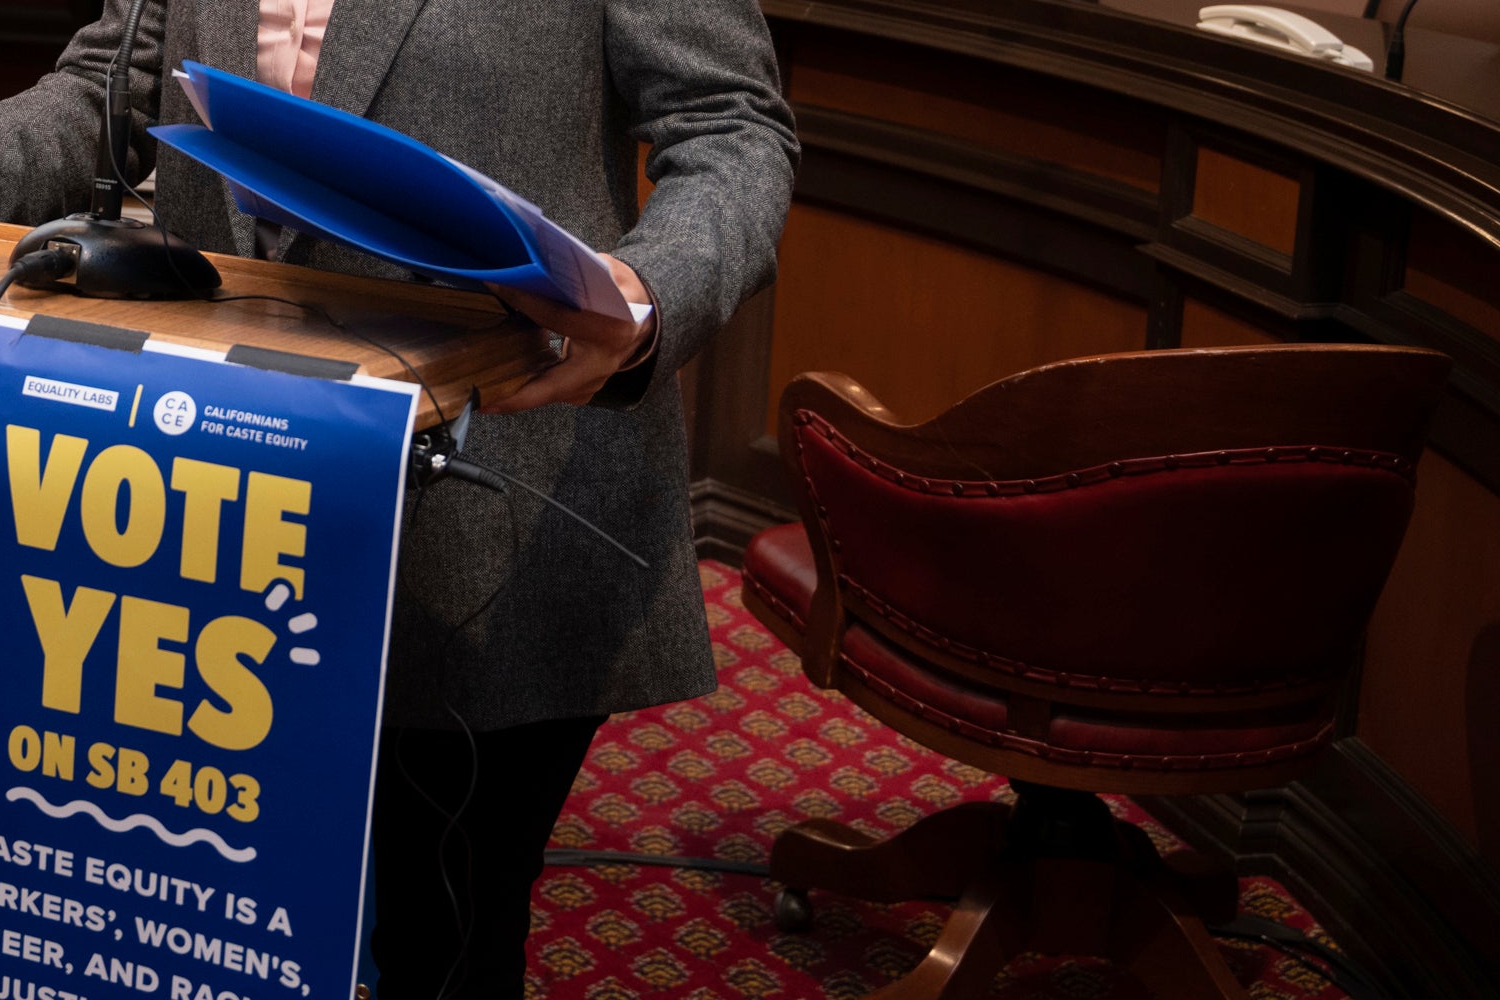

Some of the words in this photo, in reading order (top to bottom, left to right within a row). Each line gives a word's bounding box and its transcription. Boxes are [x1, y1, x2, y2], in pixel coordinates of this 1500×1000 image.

[27, 381, 81, 399] EQUALITY
[83, 391, 113, 405] LABS
[204, 405, 289, 431] CALIFORNIANS
[201, 421, 223, 435] FOR
[225, 426, 263, 443] CASTE
[265, 433, 308, 451] EQUITY
[6, 424, 312, 601] VOTE
[20, 574, 278, 751] YES
[8, 725, 76, 781] ON
[85, 742, 150, 796] SB
[159, 759, 261, 823] 403
[85, 856, 216, 912] EQUITY
[224, 893, 258, 925] IS
[267, 907, 293, 937] A
[84, 953, 160, 994] AND
[135, 916, 311, 997] WOMEN'S,
